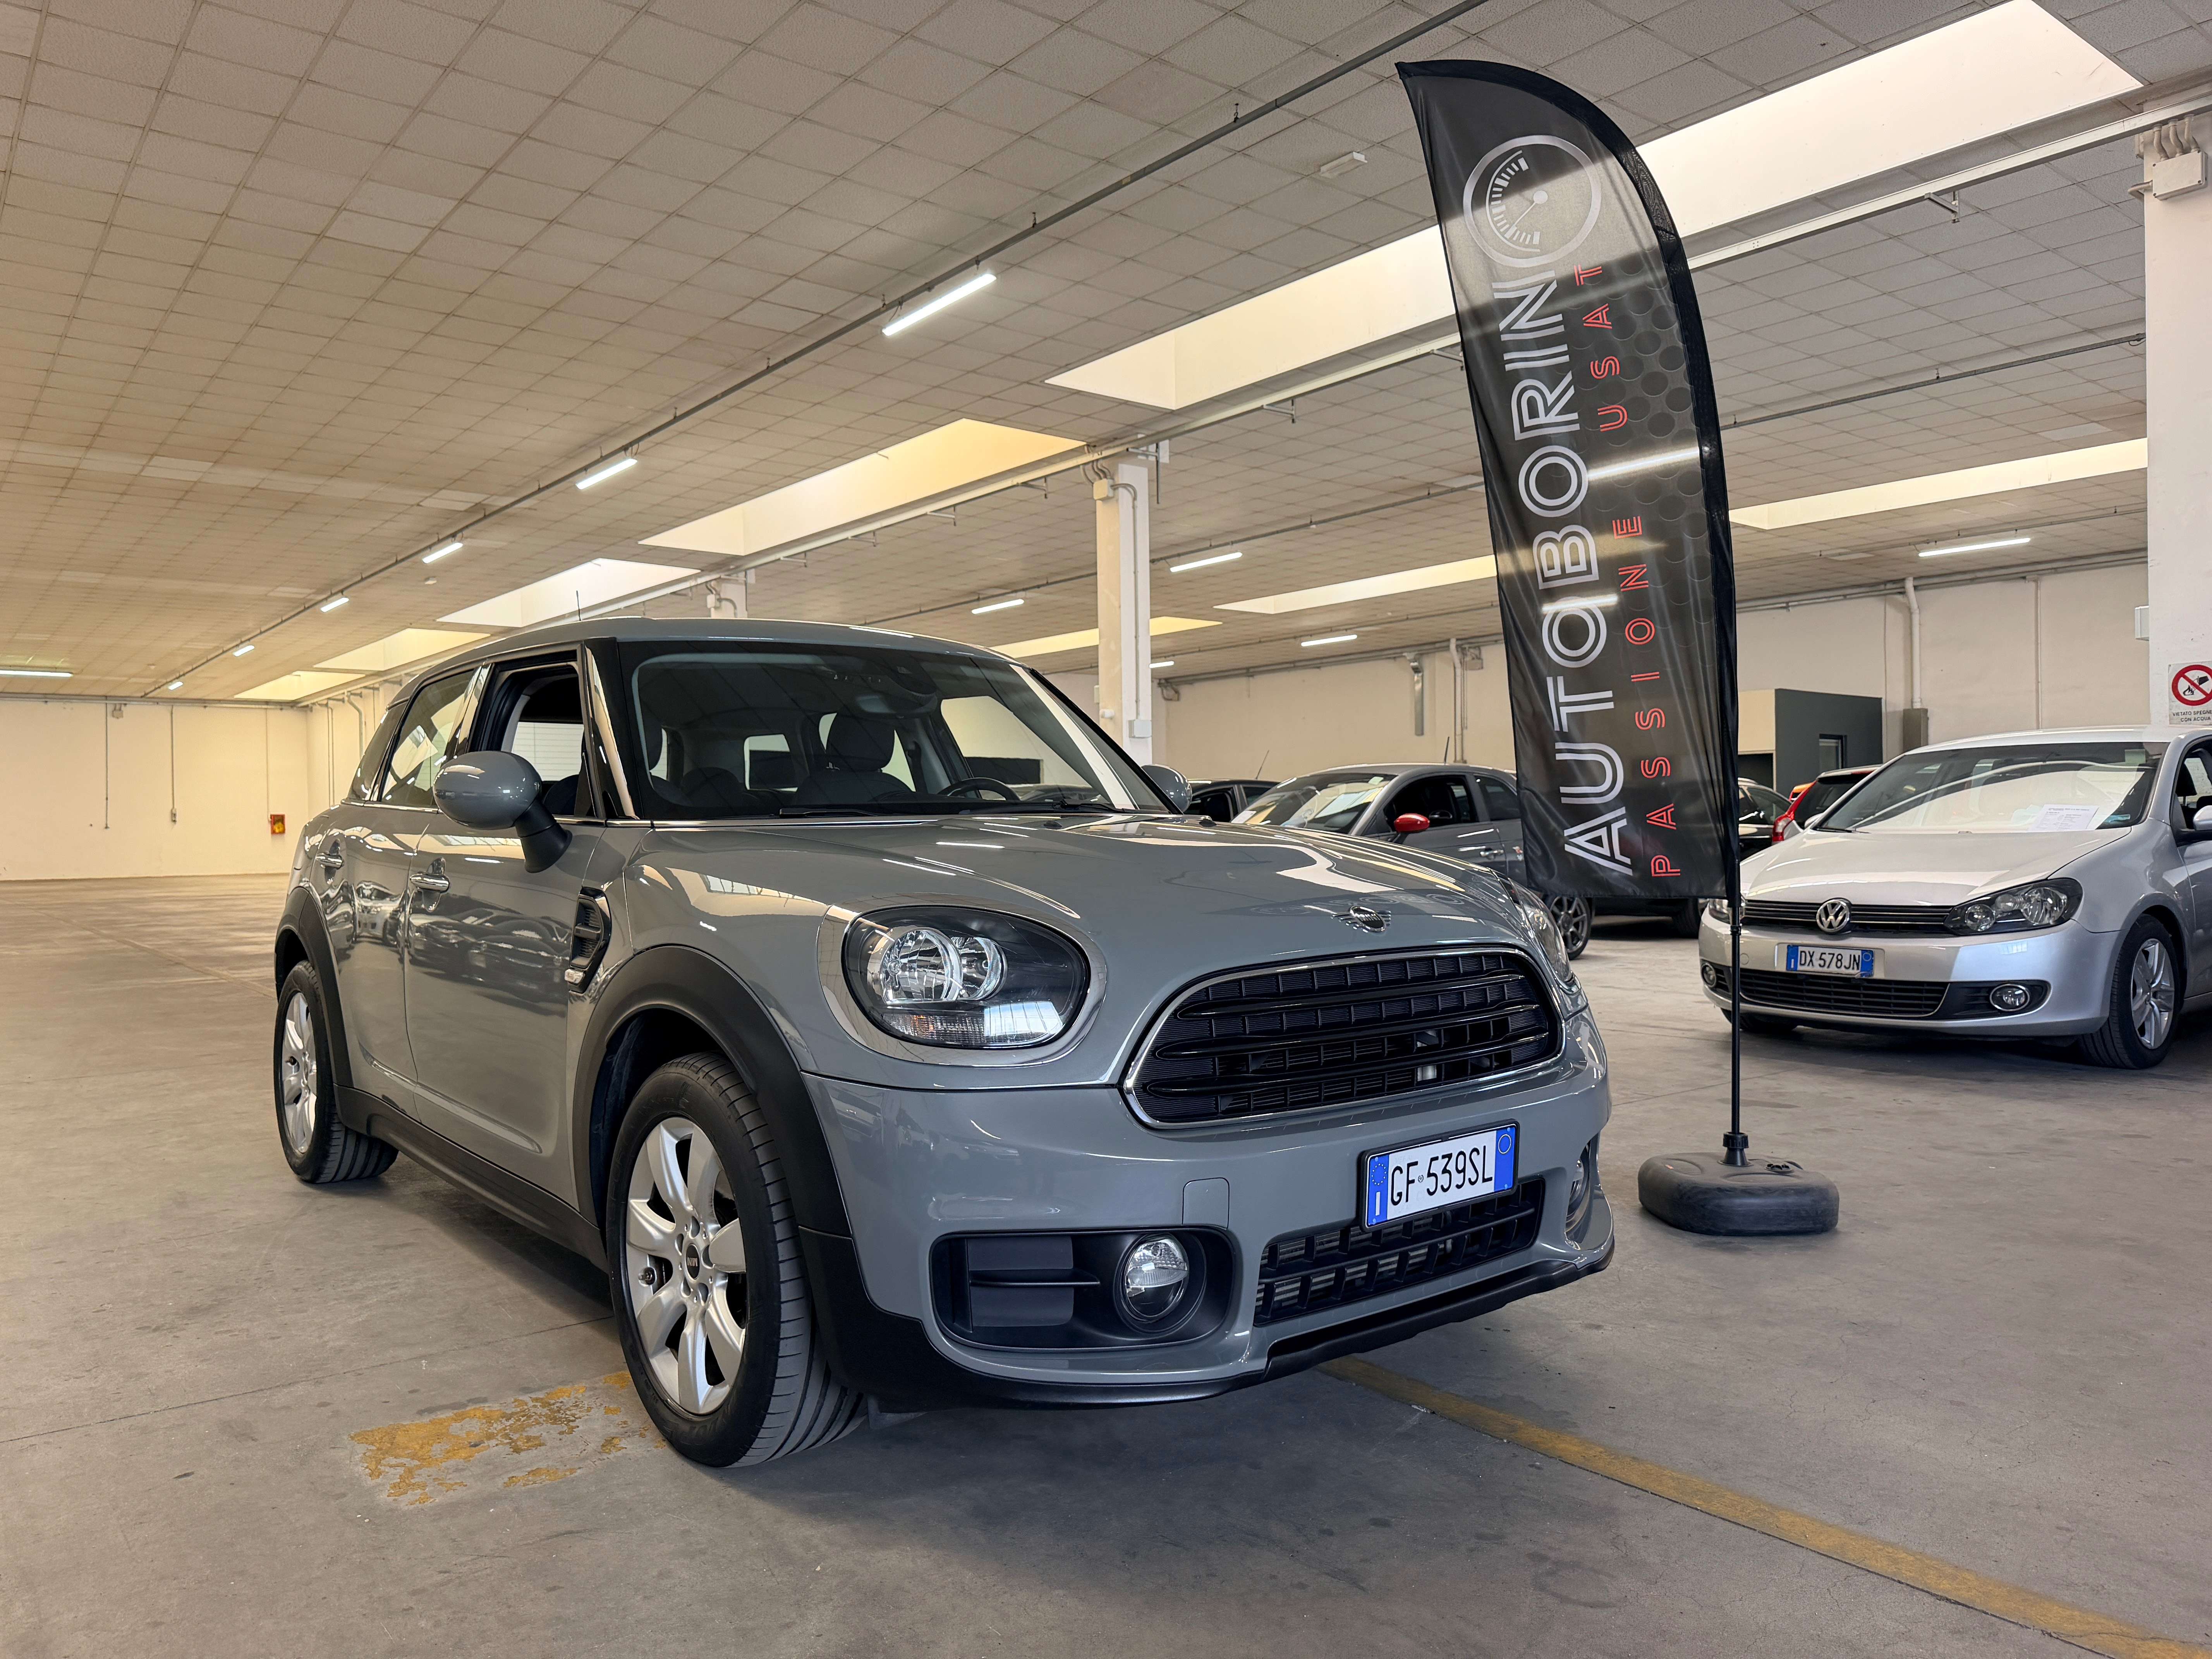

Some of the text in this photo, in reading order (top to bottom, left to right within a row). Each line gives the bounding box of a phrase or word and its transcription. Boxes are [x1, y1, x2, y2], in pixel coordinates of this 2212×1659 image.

[1613, 515, 1681, 877] PASSIONE
[1799, 950, 1815, 967] DX
[1391, 1161, 1419, 1206] GF
[1427, 1146, 1493, 1196] 539SL
